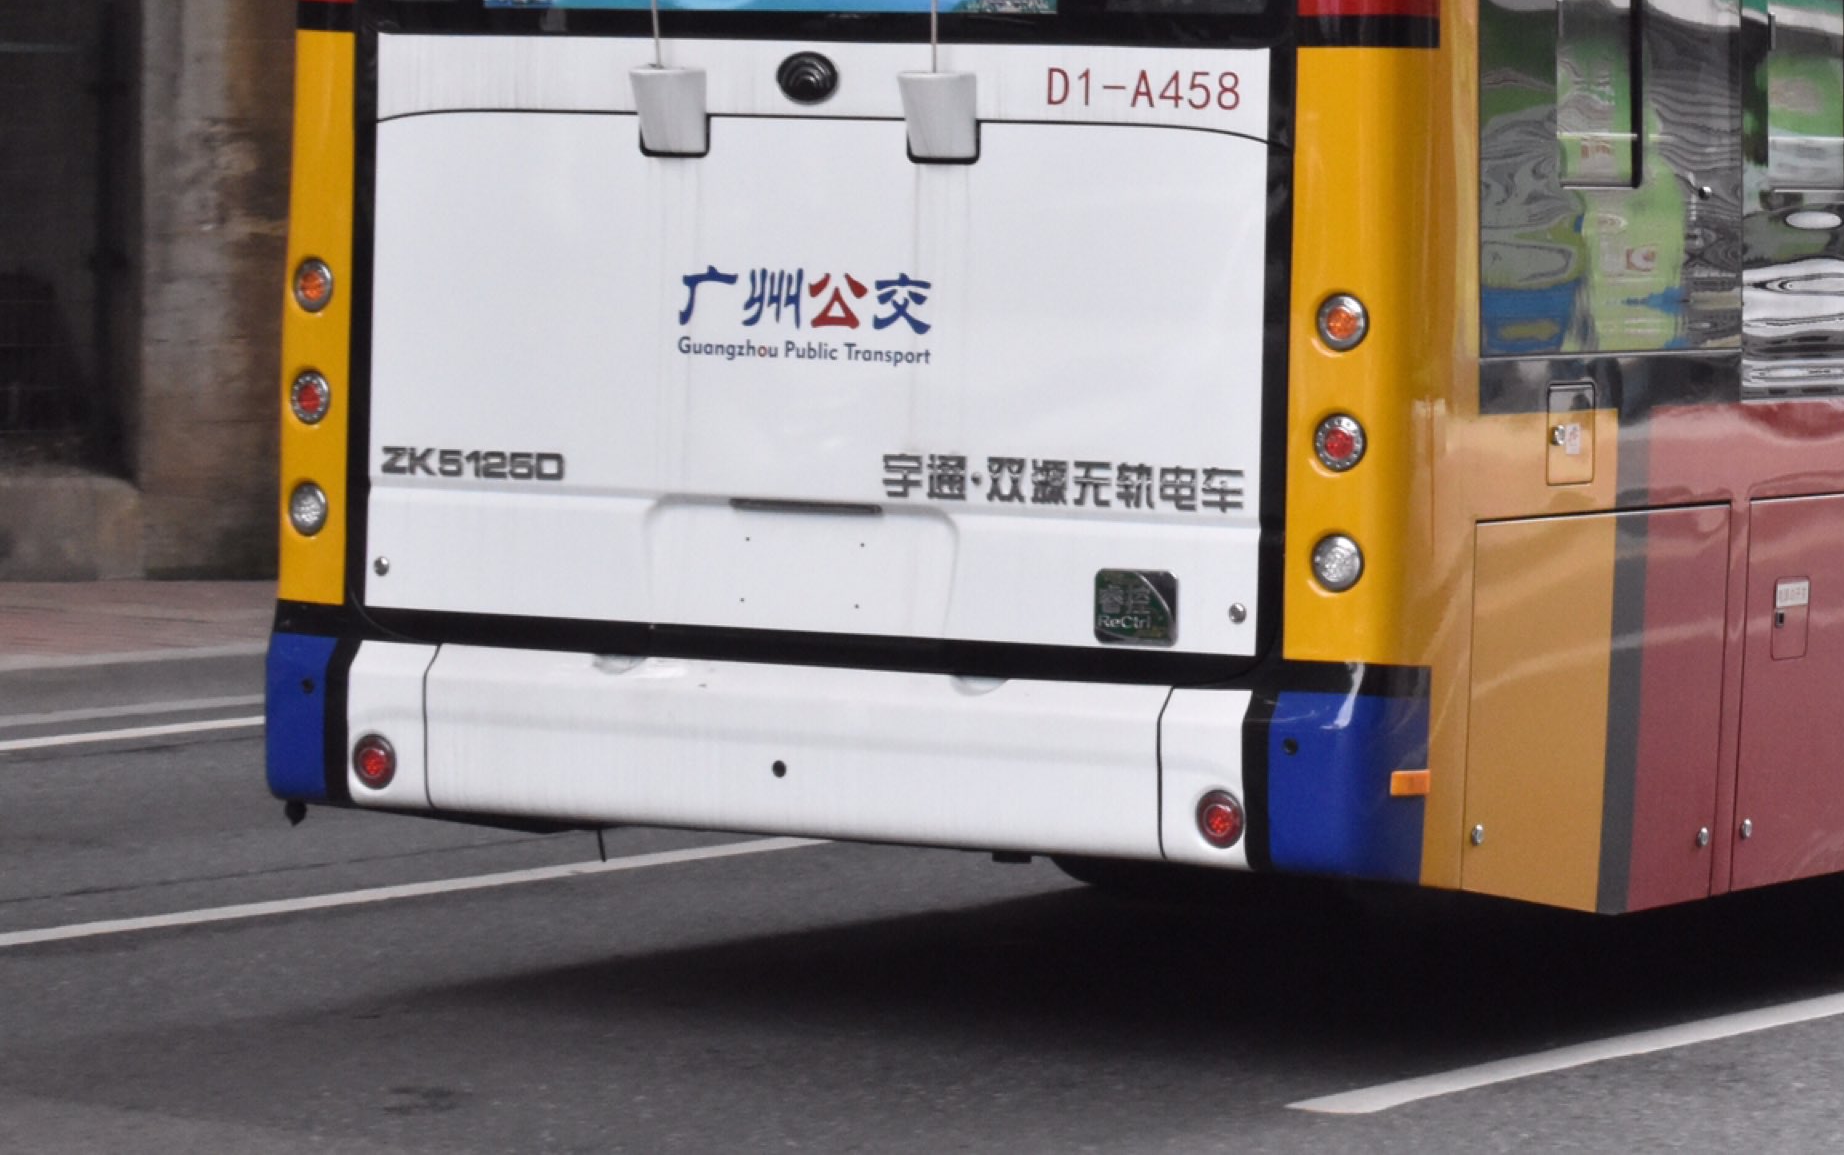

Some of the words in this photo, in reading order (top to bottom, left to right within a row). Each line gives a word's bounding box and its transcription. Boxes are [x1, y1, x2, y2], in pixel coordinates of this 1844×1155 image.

[1046, 67, 1241, 111] D1-A458
[678, 265, 932, 335] 广州公交
[678, 335, 779, 360] Guangzhou
[784, 340, 838, 361] Public
[843, 342, 932, 366] Transport
[381, 445, 565, 482] ZK5125D
